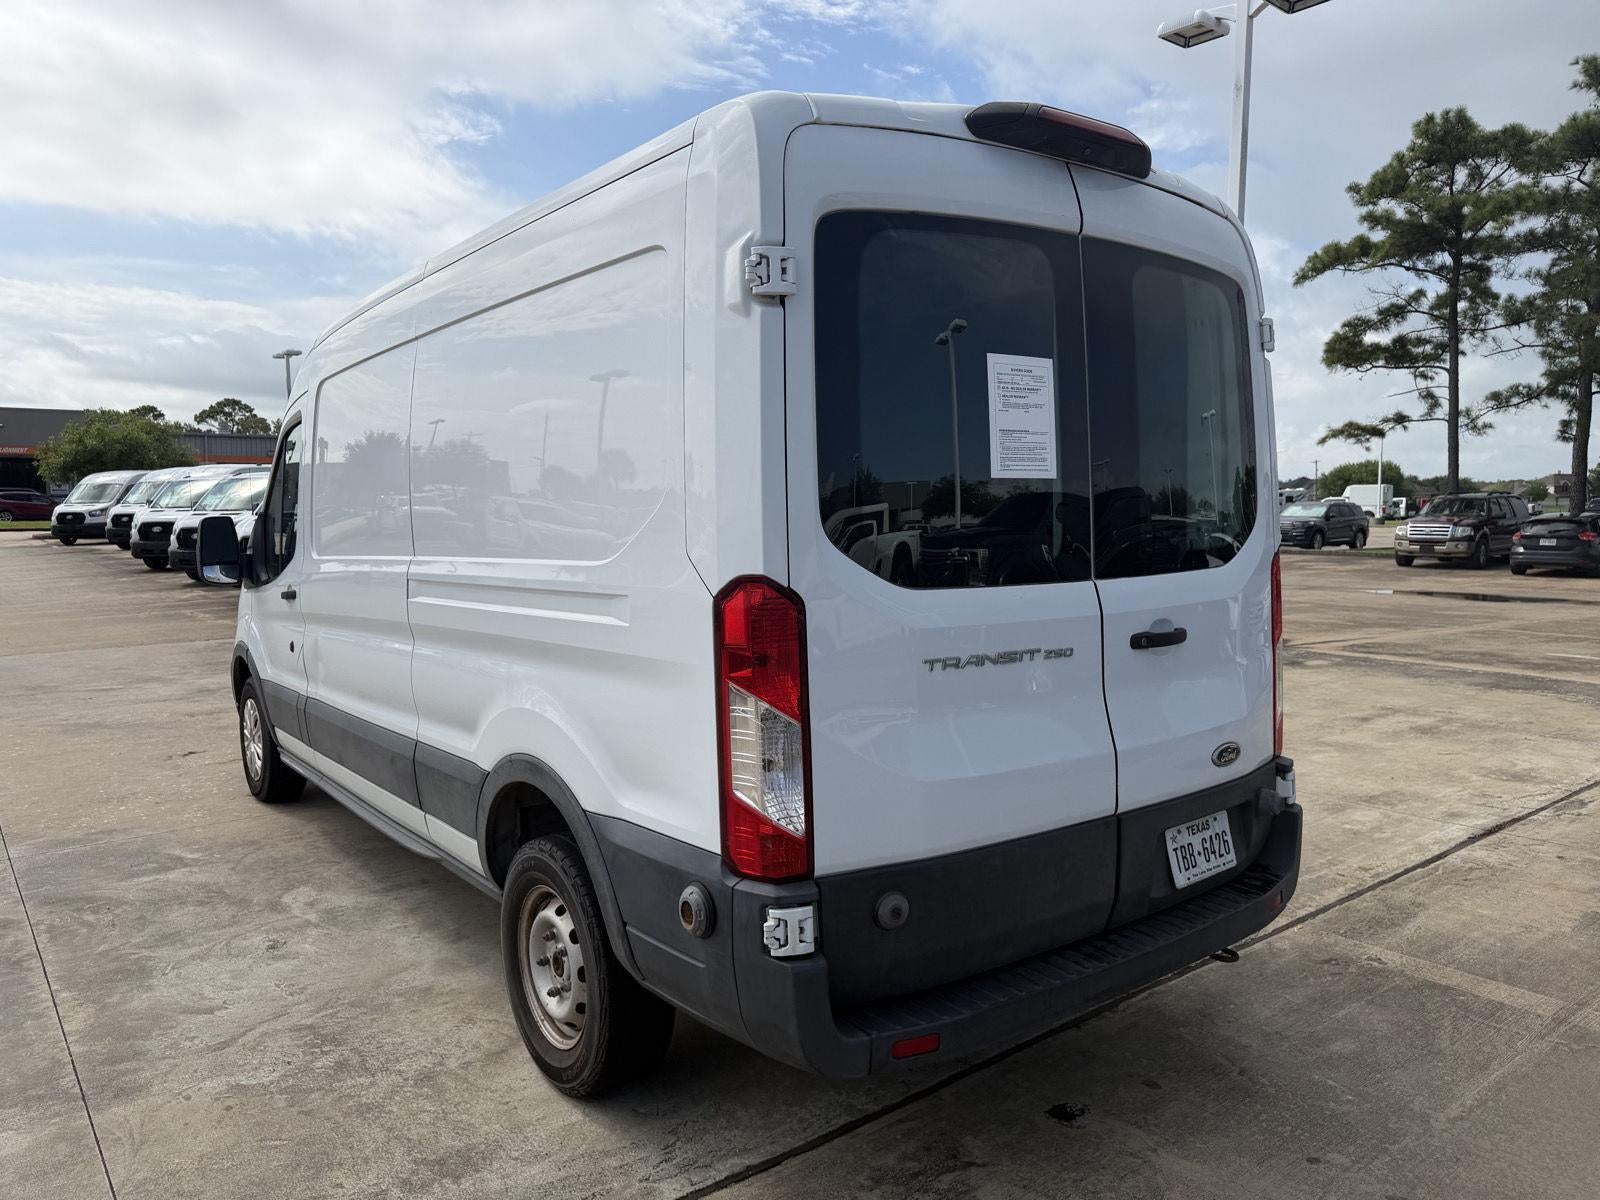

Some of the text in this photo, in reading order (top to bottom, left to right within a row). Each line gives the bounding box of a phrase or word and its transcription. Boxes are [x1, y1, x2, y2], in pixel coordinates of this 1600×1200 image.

[922, 647, 1074, 672] TRANSIT 250
[1186, 820, 1211, 837] TEXAS
